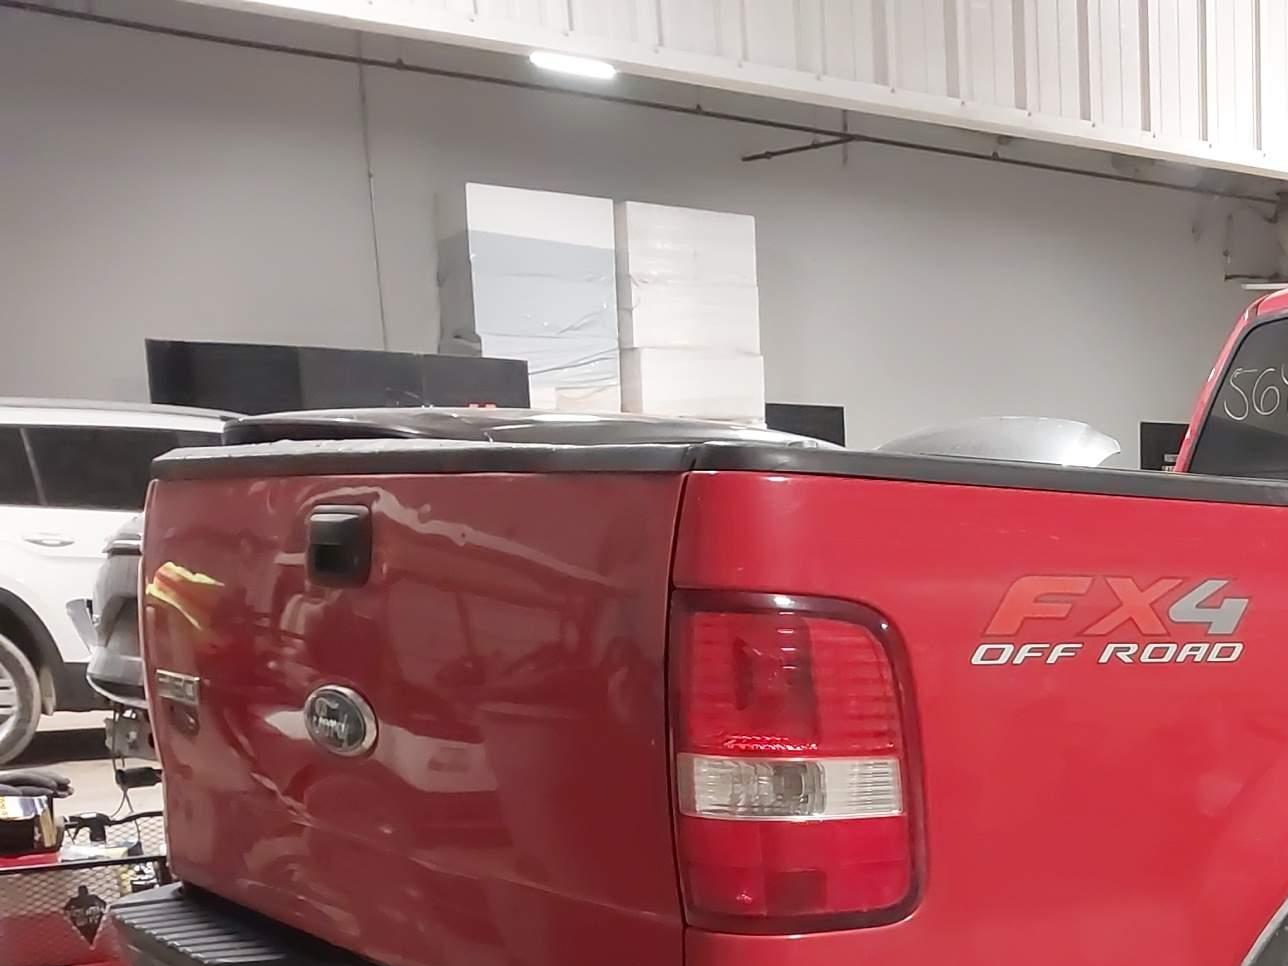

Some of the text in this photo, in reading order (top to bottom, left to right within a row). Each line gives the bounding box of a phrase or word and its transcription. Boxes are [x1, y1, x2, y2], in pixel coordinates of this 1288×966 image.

[981, 574, 1252, 637] FX4
[969, 641, 1245, 666] OFF ROAD
